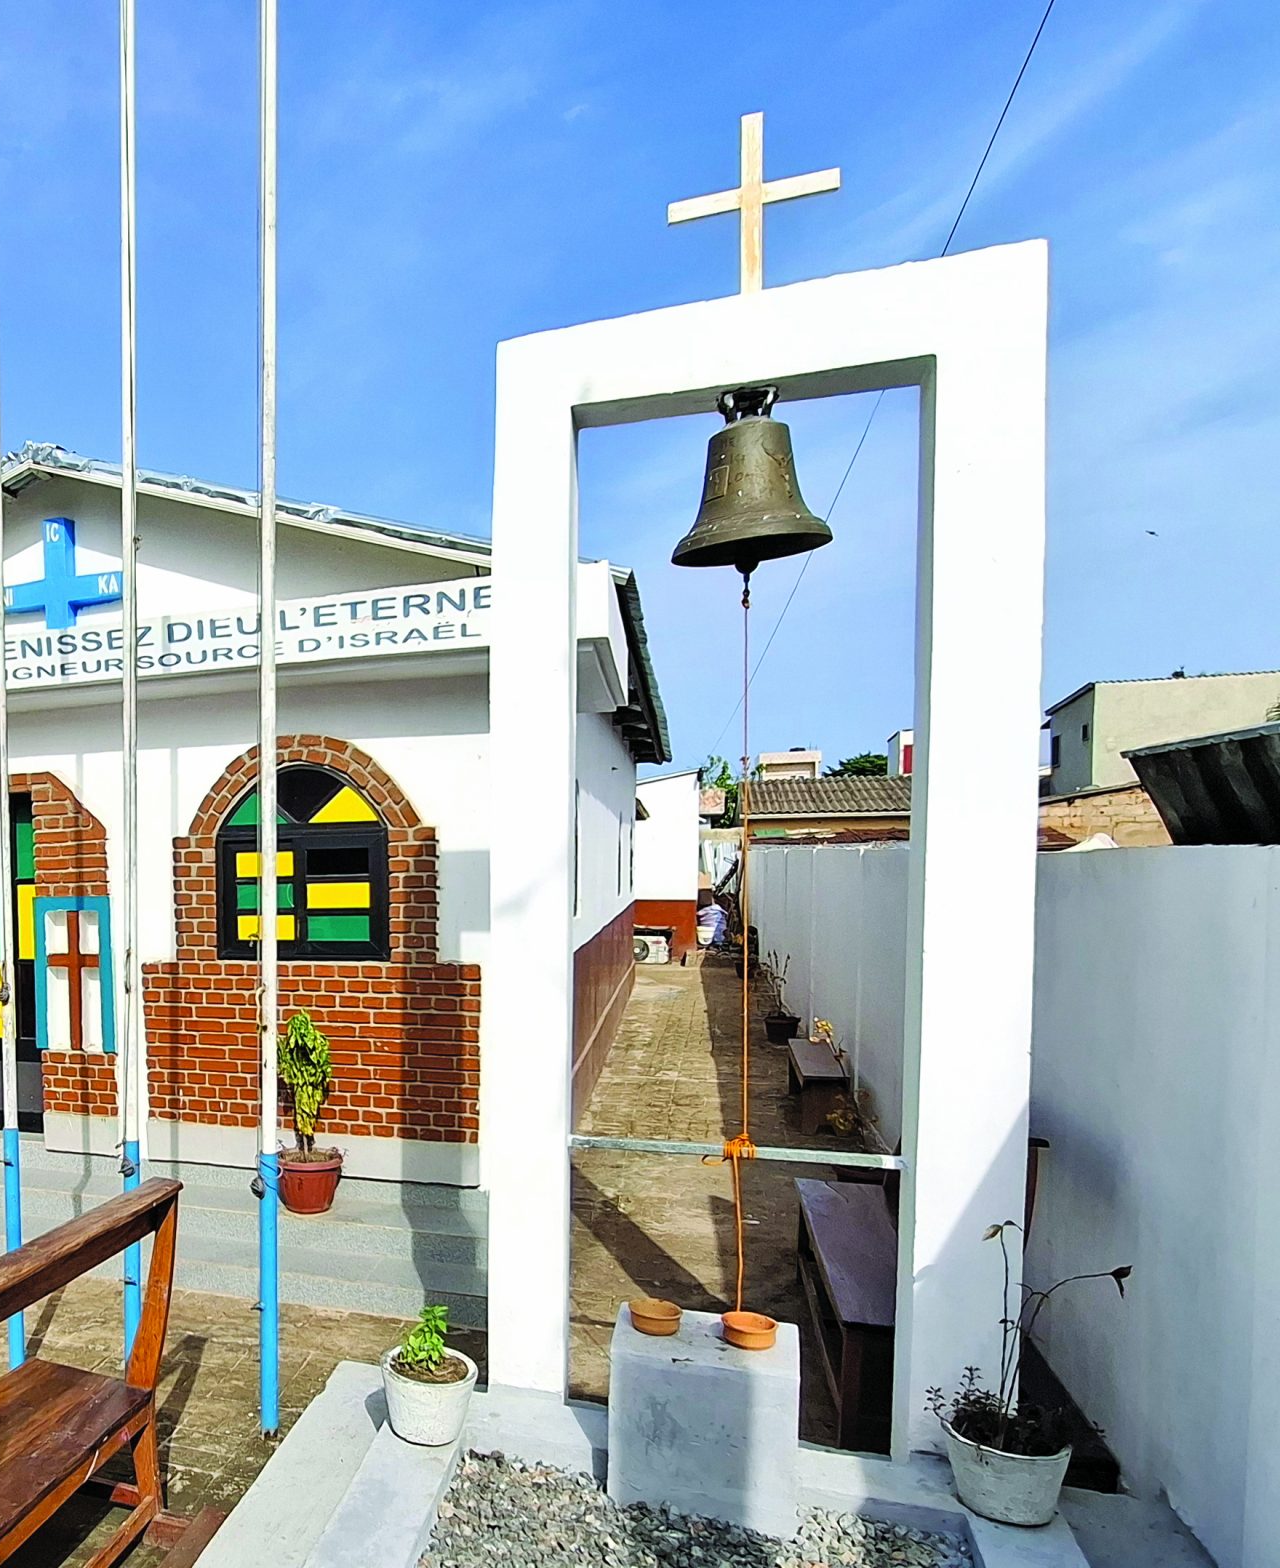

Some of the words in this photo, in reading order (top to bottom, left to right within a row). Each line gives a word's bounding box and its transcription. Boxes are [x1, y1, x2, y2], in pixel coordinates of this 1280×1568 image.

[46, 522, 60, 543] IC
[97, 573, 119, 595] KA
[166, 613, 261, 644] DIEU
[298, 621, 482, 653] D'ISRAËL
